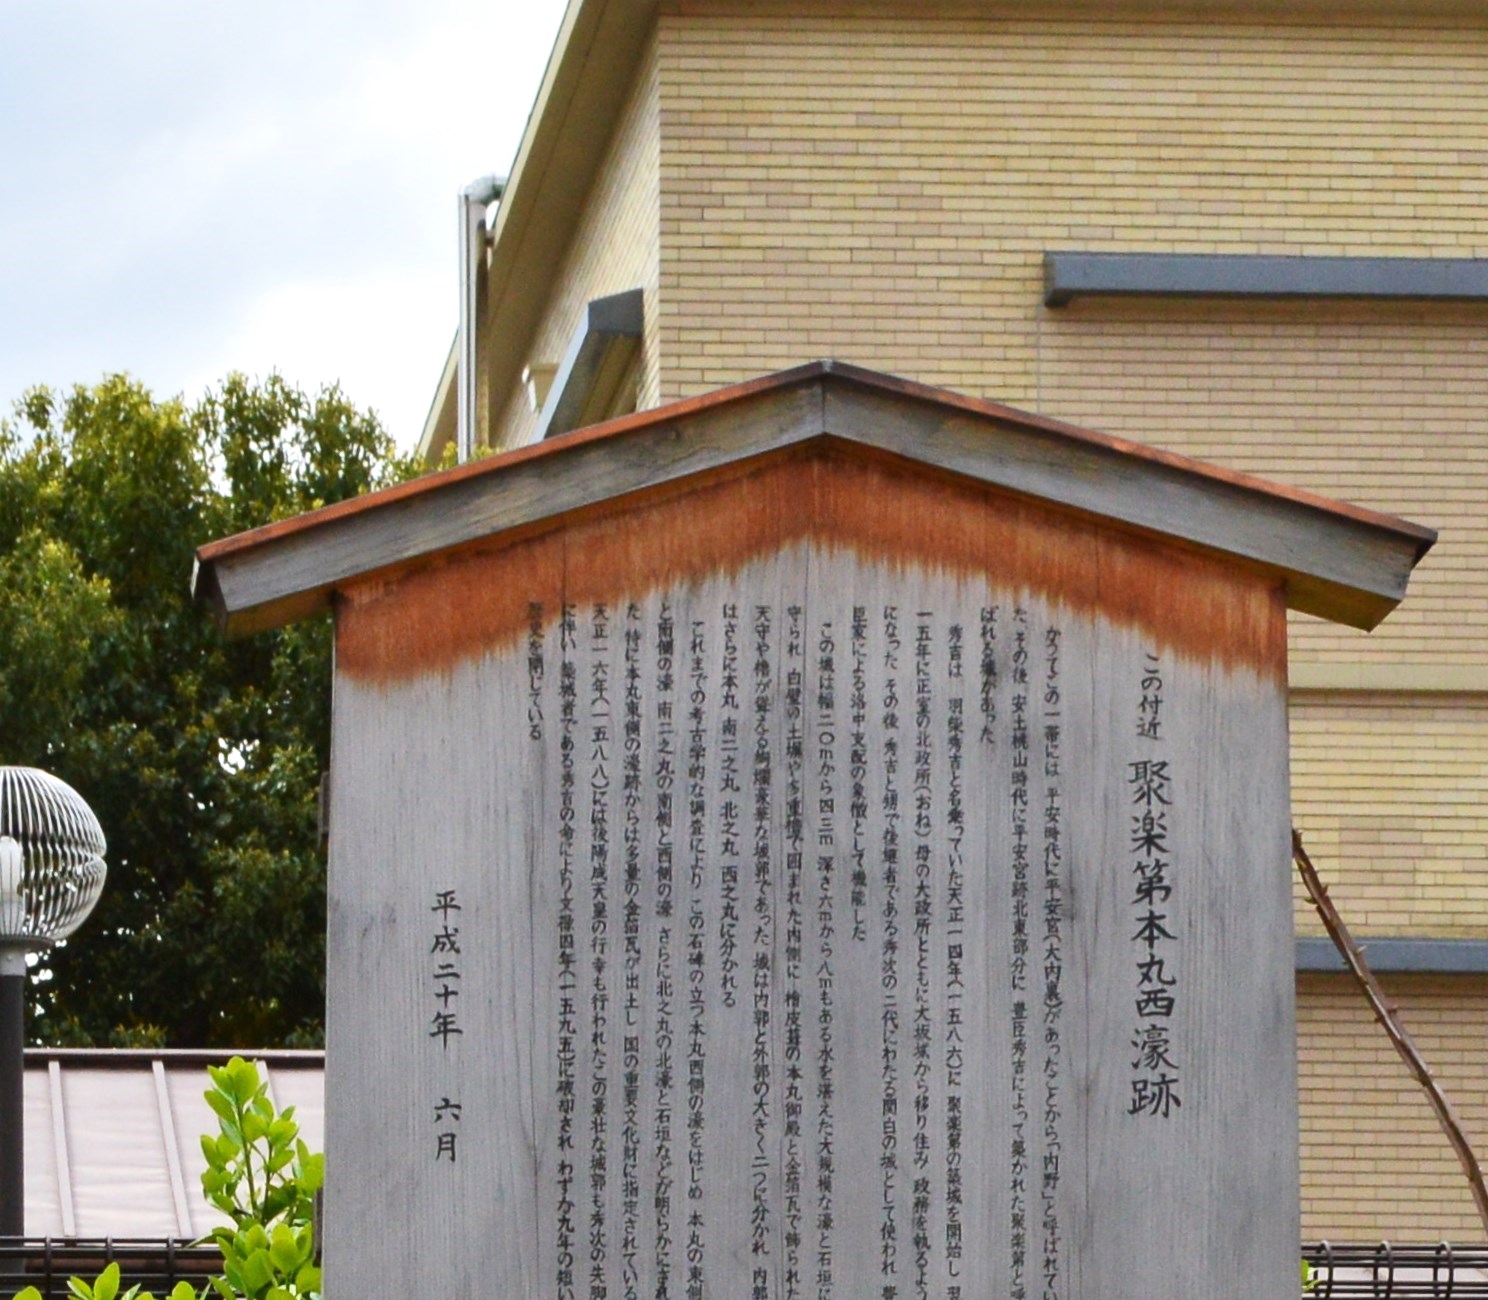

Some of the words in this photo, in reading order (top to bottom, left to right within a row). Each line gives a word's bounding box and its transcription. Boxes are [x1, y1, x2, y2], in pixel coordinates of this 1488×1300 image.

[1137, 653, 1164, 740] この付近
[431, 890, 462, 1049] 平成二十年
[1127, 759, 1184, 1118] 聚楽第本丸西濠跡
[433, 1097, 463, 1163] 六月
